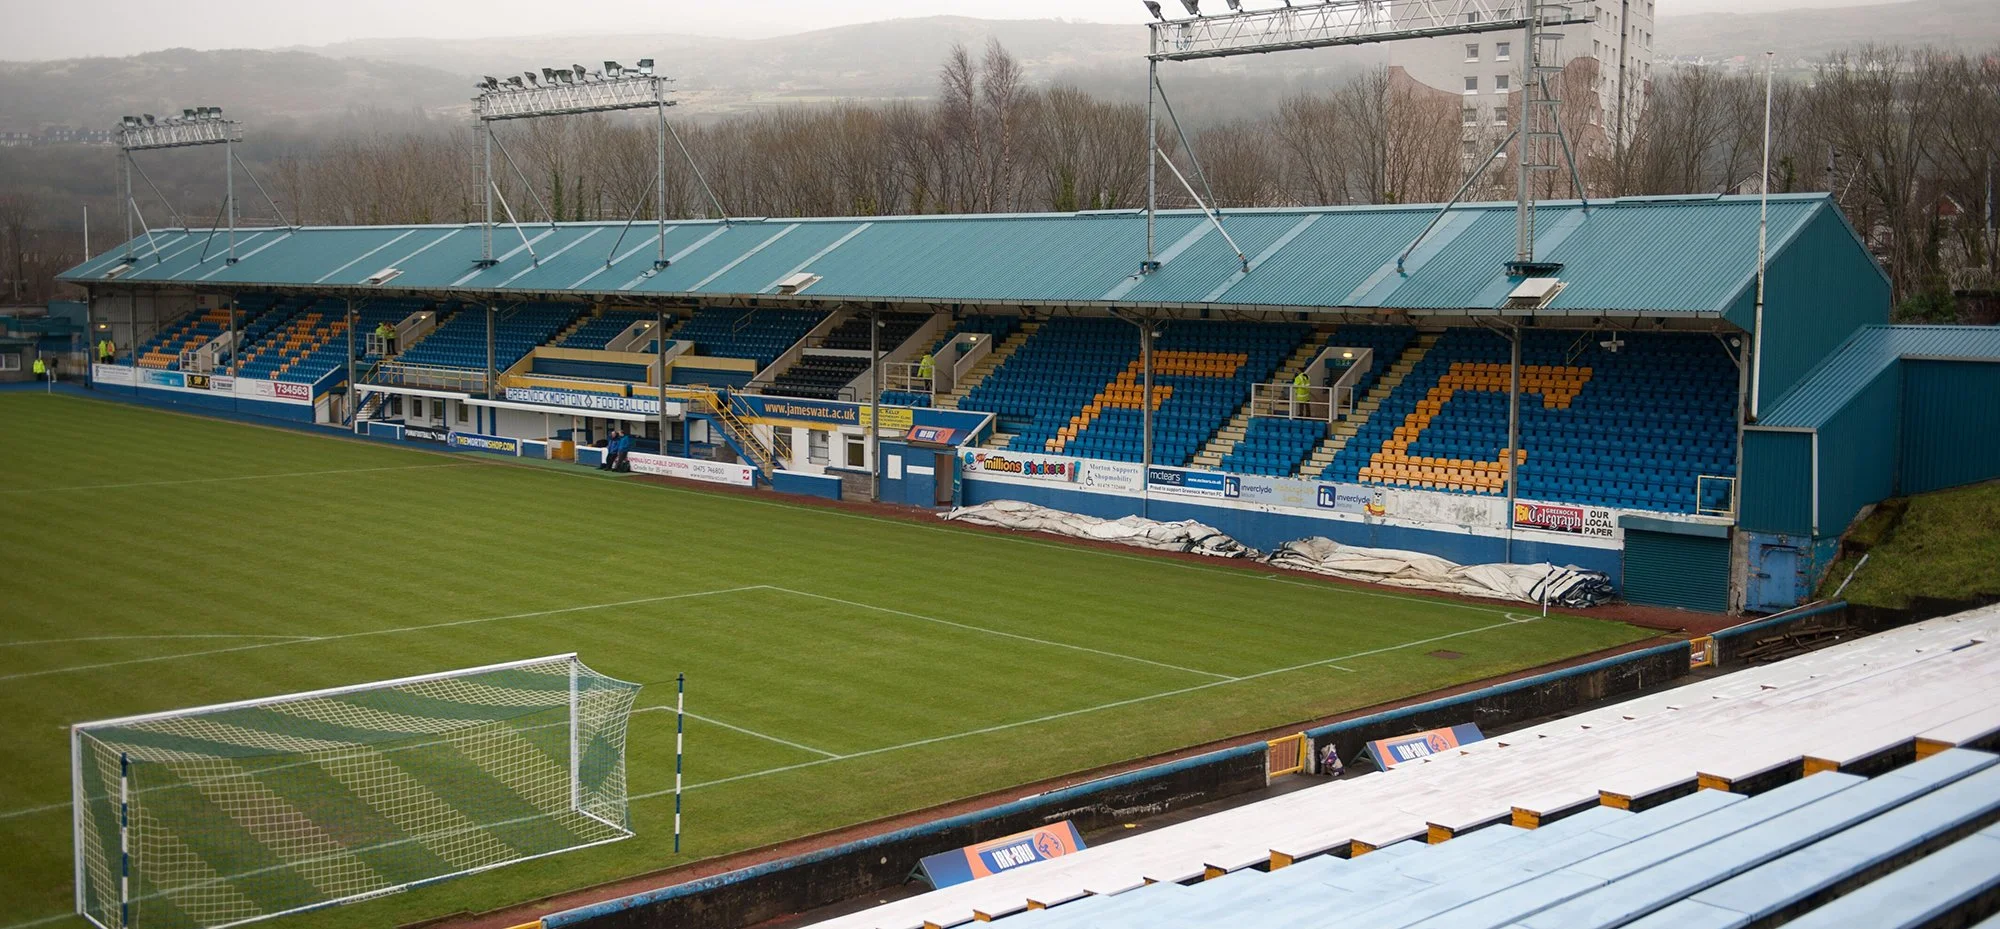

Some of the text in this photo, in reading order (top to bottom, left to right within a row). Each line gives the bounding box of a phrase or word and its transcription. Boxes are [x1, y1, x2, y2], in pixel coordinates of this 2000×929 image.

[276, 384, 308, 396] 734563
[507, 388, 660, 413] GREENOCK MORTON FOOTBALL CLU
[764, 403, 856, 421] www.jameswatt.ac.uk
[456, 436, 515, 452] THEMORTONSHOP.COM
[653, 459, 667, 467] CABLE
[668, 461, 689, 470] DIVISION
[692, 465, 725, 475] 01475 746800
[984, 456, 1022, 473] millions
[1023, 460, 1066, 476] Shakers
[1089, 463, 1138, 474] Morton Supports
[1094, 472, 1132, 483] Shopmobility
[1150, 471, 1181, 482] mctears
[1241, 484, 1272, 495] inverclyde
[1336, 495, 1370, 505] inverclyde
[1546, 507, 1574, 516] GREENOCK
[1589, 510, 1609, 520] OUR
[1528, 504, 1581, 532] Telegraph
[1585, 518, 1613, 529] LOCAL
[1584, 527, 1613, 537] PAPER
[1396, 741, 1430, 760] IRN-BRU
[991, 843, 1036, 870] IRN-BRU
